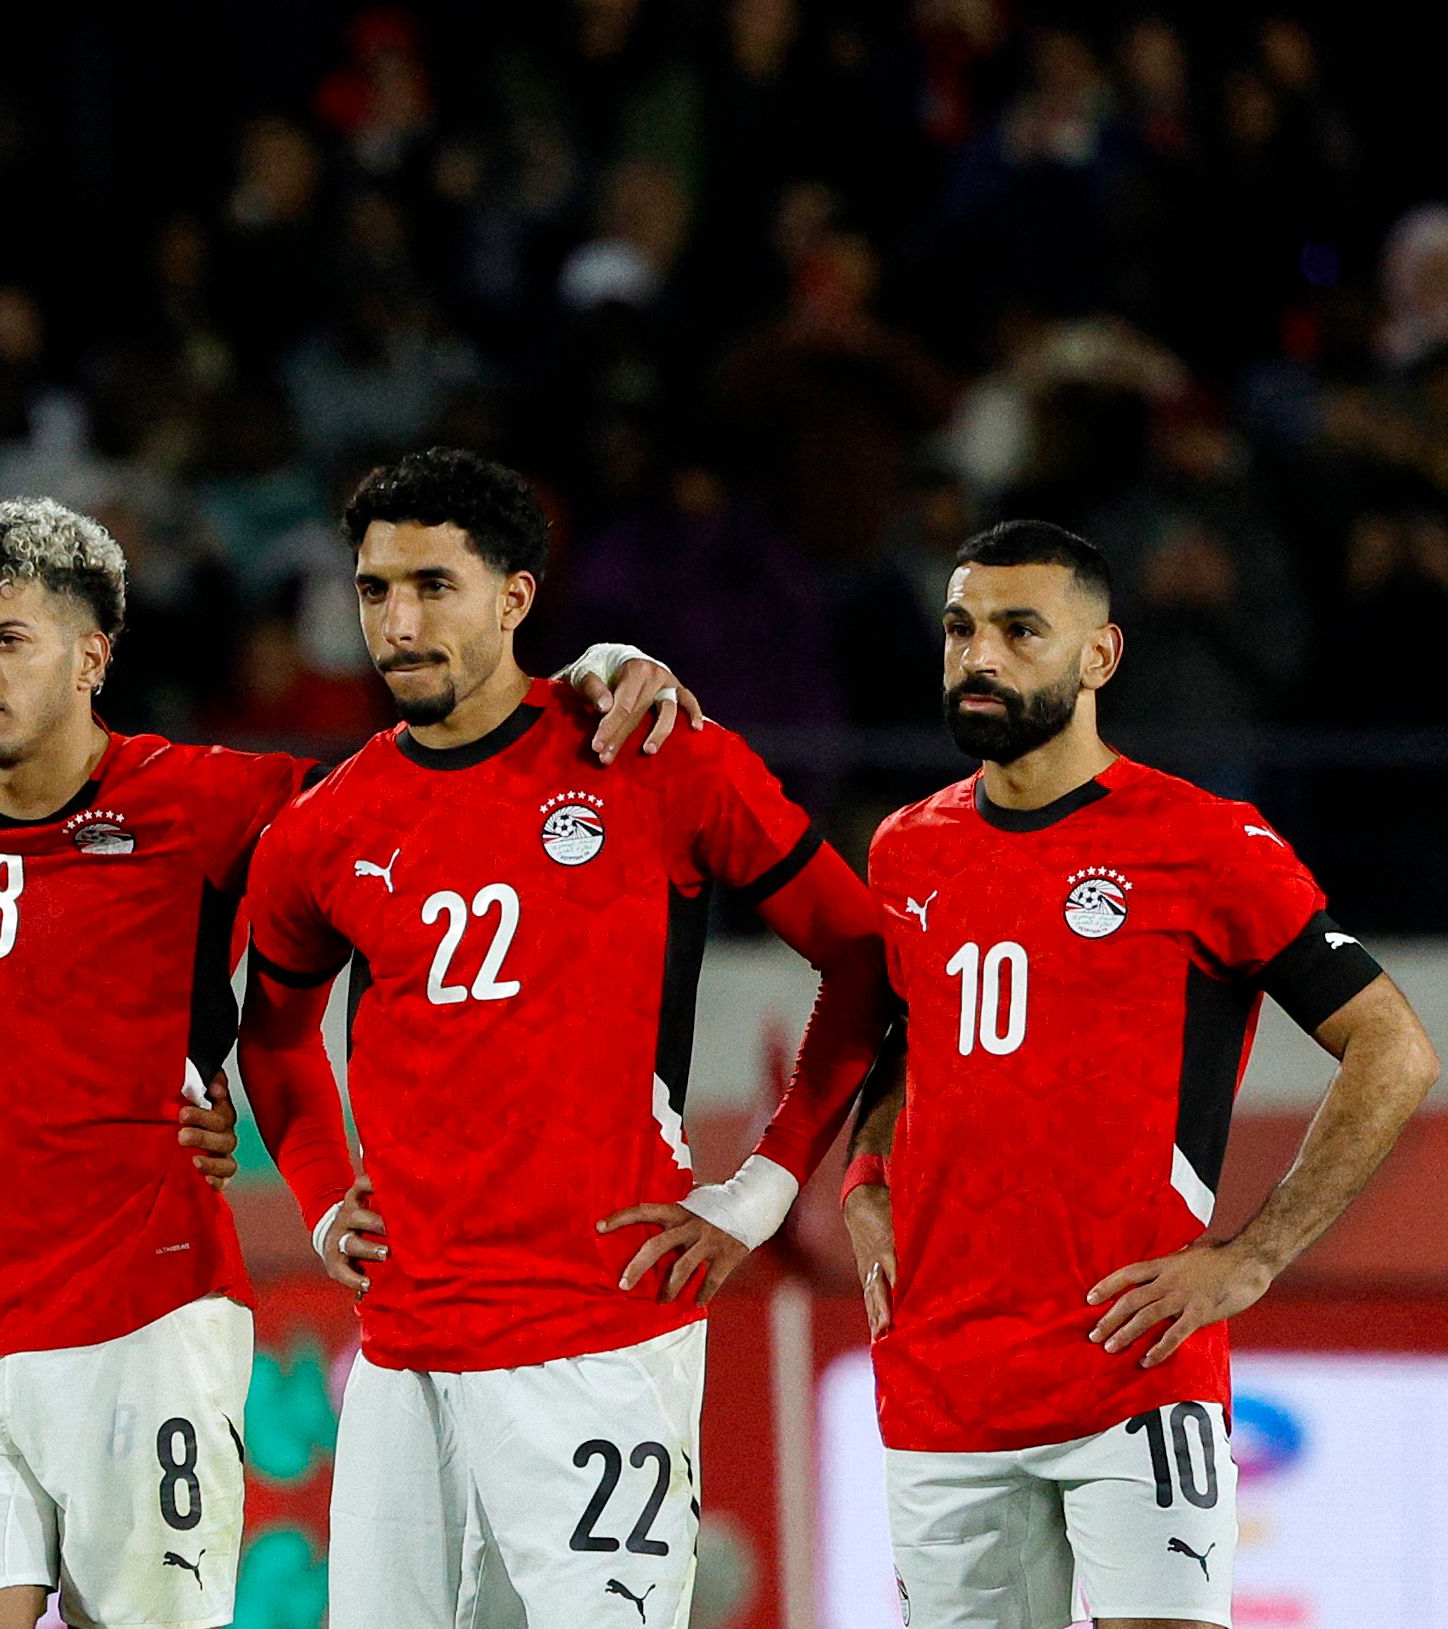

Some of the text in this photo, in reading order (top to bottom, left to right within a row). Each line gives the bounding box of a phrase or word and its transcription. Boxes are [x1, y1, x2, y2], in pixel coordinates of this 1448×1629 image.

[421, 883, 521, 1005] 22
[945, 940, 1028, 1056] 10
[156, 1417, 204, 1531] 8
[569, 1439, 672, 1557] 22
[1125, 1400, 1218, 1509] 10
